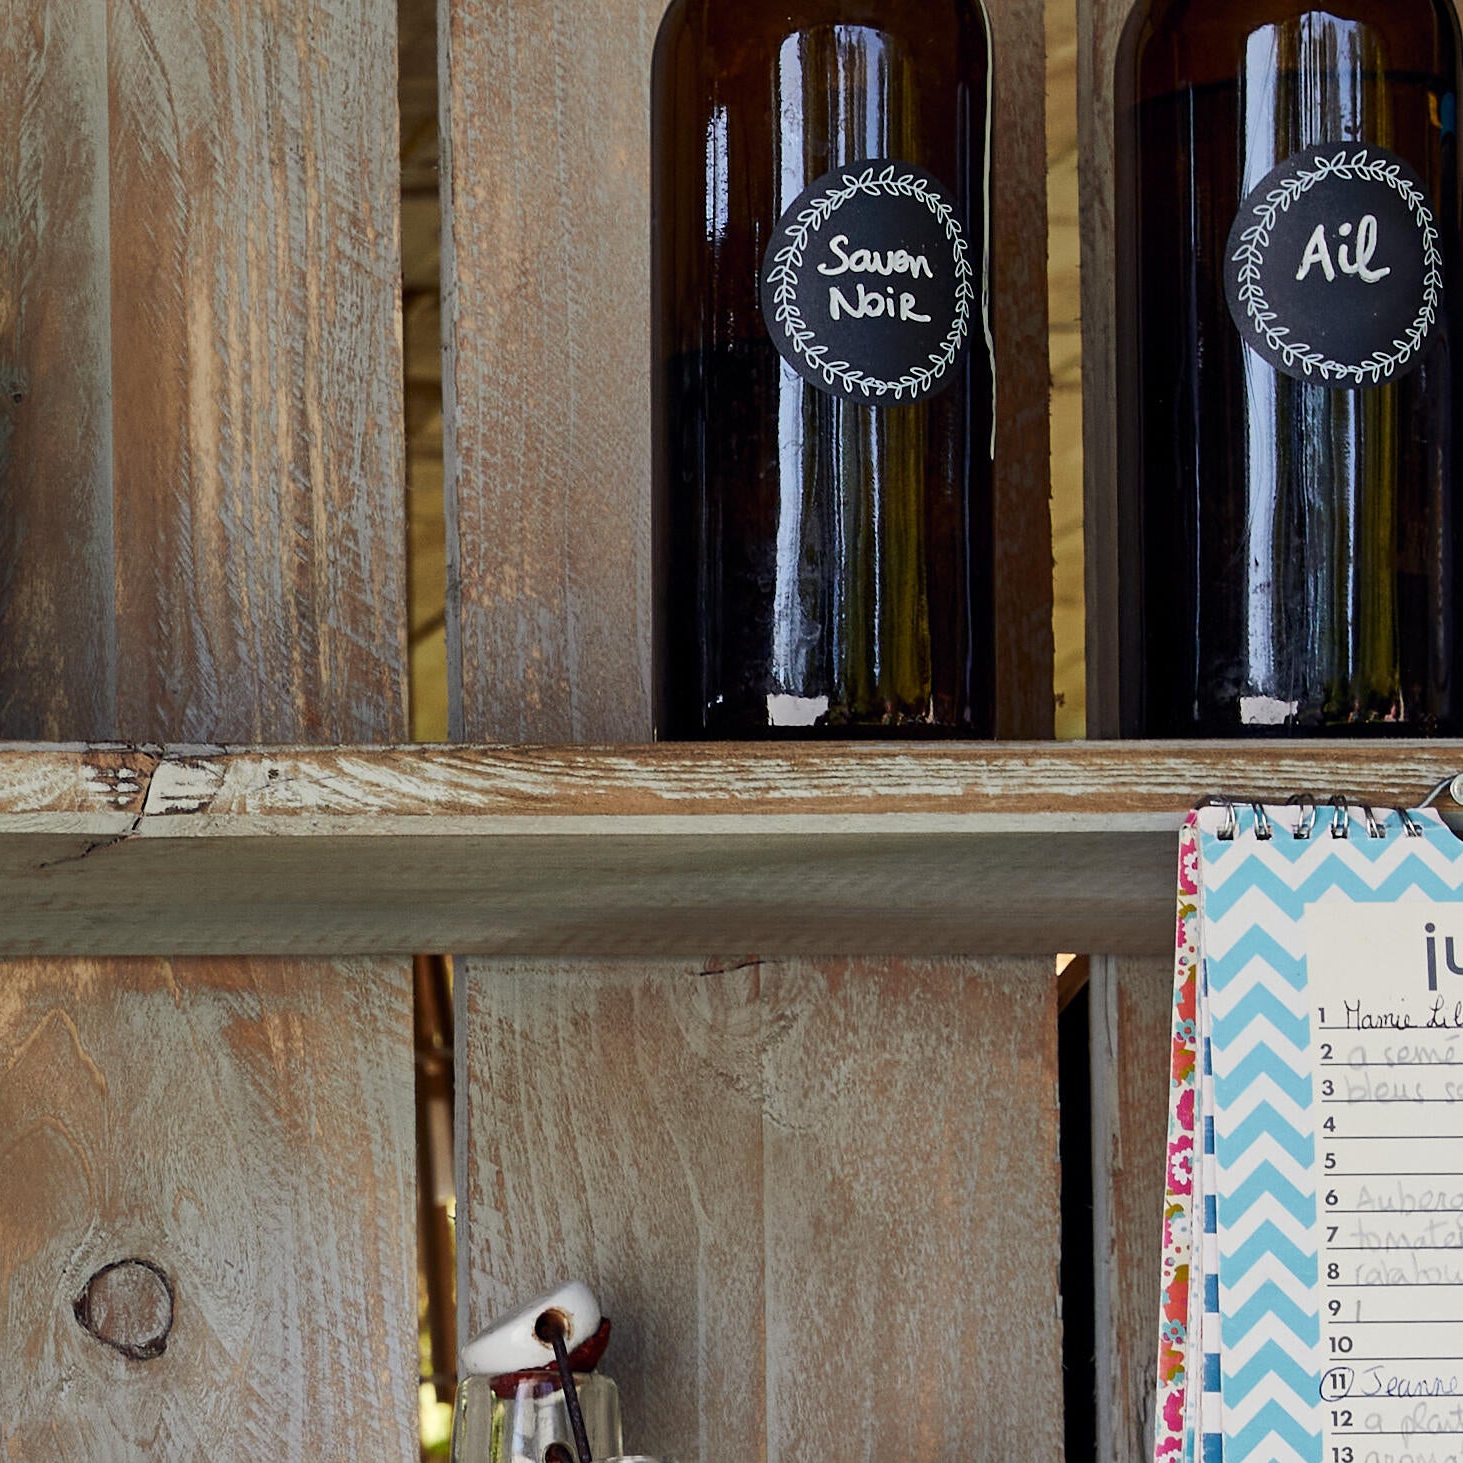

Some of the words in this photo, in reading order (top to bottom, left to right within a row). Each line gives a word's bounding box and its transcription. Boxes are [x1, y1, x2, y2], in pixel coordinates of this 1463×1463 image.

[818, 234, 933, 279] Savon
[1297, 215, 1391, 283] Ail
[1318, 1007, 1326, 1023] 1
[1320, 1043, 1333, 1060] 2
[1322, 1080, 1334, 1096] 3
[1323, 1116, 1336, 1132] 4
[1324, 1152, 1336, 1169] 5
[1325, 1189, 1338, 1206] 6
[1326, 1226, 1339, 1242] 7
[1327, 1262, 1340, 1280] 8
[1328, 1300, 1341, 1316] 9
[1329, 1336, 1353, 1353] 10
[1330, 1373, 1346, 1390] 11
[1361, 1365, 1458, 1397] Jeanne
[1331, 1410, 1353, 1427] 12
[1332, 1447, 1354, 1463] 13
